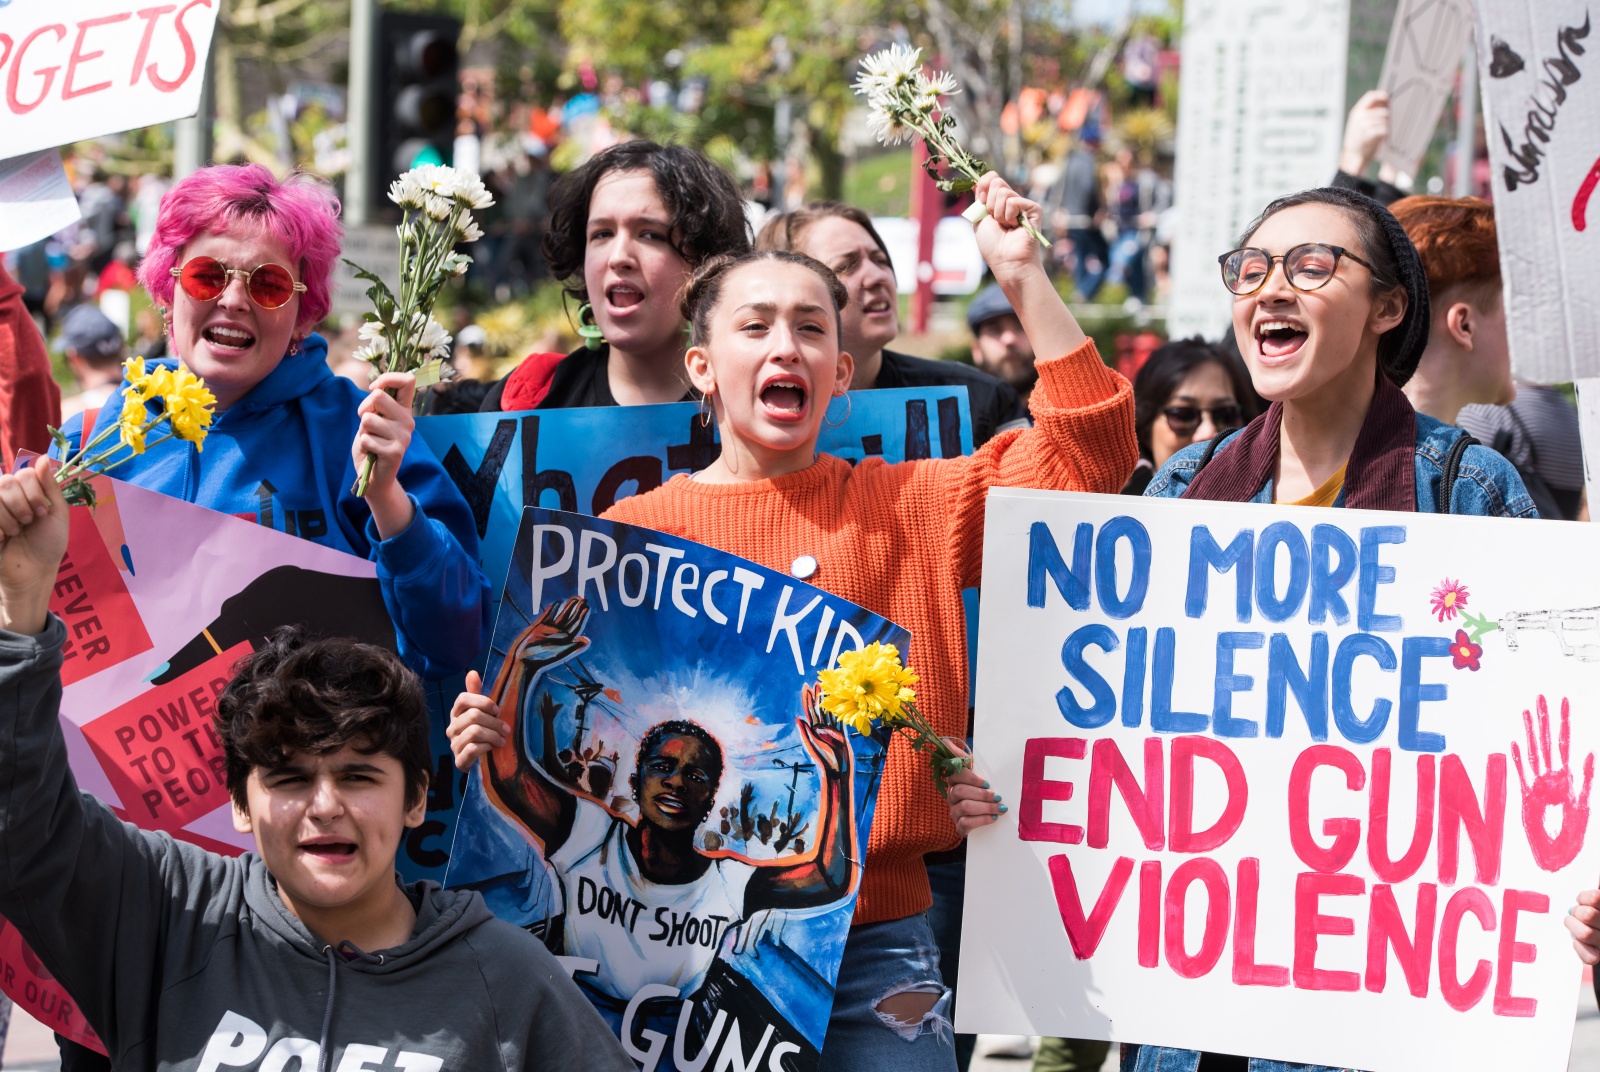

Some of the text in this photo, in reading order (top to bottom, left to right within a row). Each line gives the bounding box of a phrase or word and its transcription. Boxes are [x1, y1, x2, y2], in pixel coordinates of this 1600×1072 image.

[1027, 515, 1407, 634] NO MORE
[1055, 623, 1452, 753] SILENCE
[129, 746, 176, 785] TO
[1018, 735, 1507, 887] END GUN
[577, 876, 730, 951] DONT SHOOT
[1048, 853, 1550, 1018] VIOLENCE
[24, 980, 74, 1026] OUR
